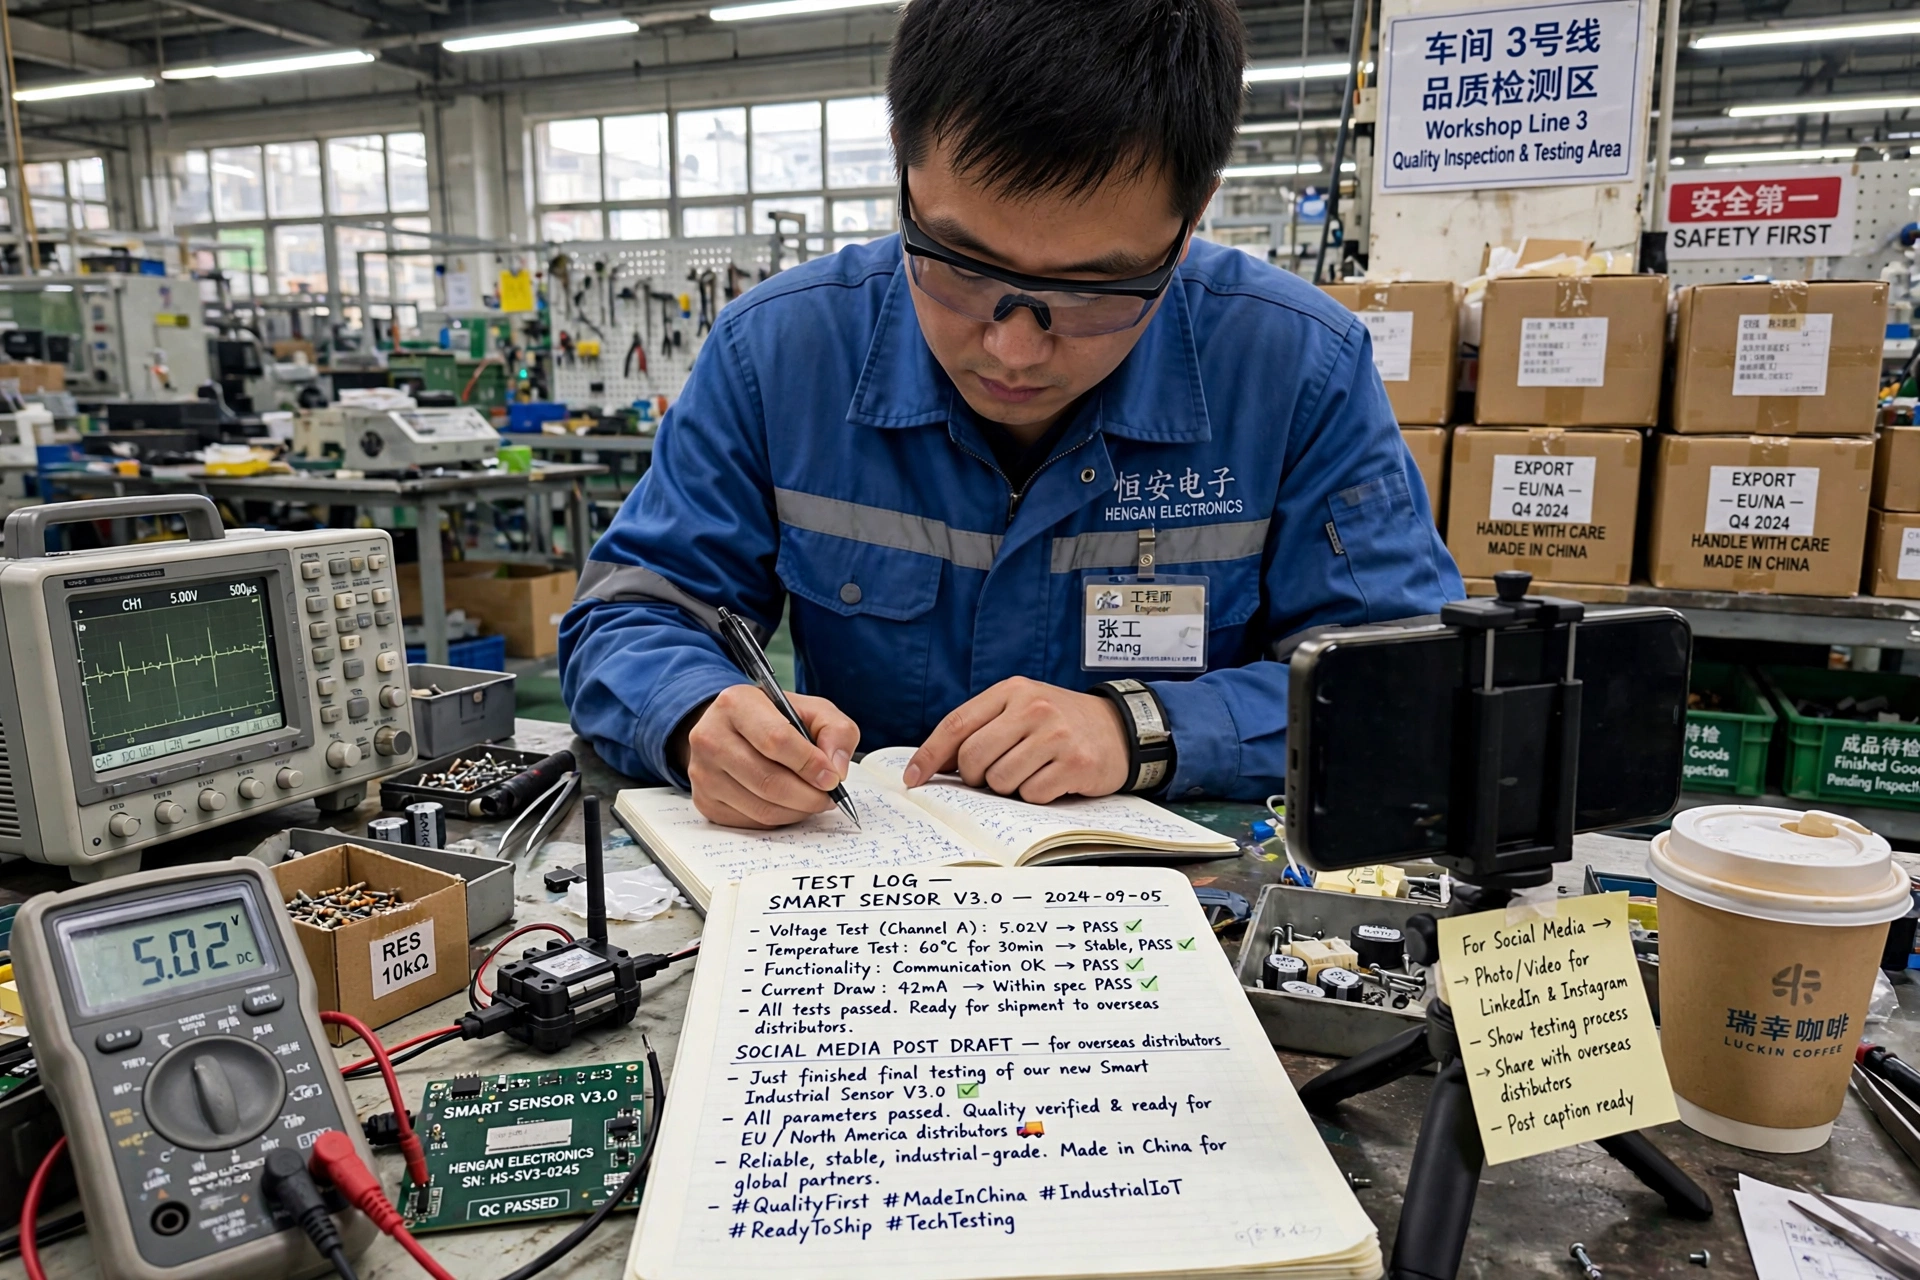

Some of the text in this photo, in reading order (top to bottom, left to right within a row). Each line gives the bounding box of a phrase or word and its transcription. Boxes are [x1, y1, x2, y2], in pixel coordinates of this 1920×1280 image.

[1425, 18, 1601, 65] 车间 3号线
[1423, 65, 1598, 111] 品质检测区
[1426, 111, 1587, 139] Workshop Line 3
[1393, 140, 1621, 172] Quality Inspection & Testing Area
[1691, 185, 1818, 218] 安全第一
[1674, 224, 1831, 248] SAFETY FIRST
[1514, 461, 1574, 476] EXPORT
[1732, 472, 1796, 487] EXPORT
[1113, 467, 1235, 503] 恒安电子
[1519, 482, 1564, 497] EU/NA
[1105, 500, 1243, 521] HENGAN ELECTRONICS
[1512, 502, 1568, 517] Q4 2024
[1737, 494, 1785, 509] EU/NA
[1477, 522, 1606, 540] HANDLE WITH CARE
[1729, 514, 1789, 530] Q4 2024
[1488, 542, 1587, 558] MADE IN CHINA
[1692, 534, 1830, 551] HANDLE WITH CARE
[1704, 555, 1809, 571] MADE IN CHINA
[122, 598, 142, 611] CH1
[170, 590, 198, 604] 5.00V
[1130, 591, 1172, 603] 工程师
[1098, 619, 1141, 638] 张工
[1097, 641, 1141, 656] Zhang
[1688, 745, 1729, 761] Goods
[1834, 755, 1887, 773] Finished
[1827, 773, 1872, 792] Pending
[792, 874, 917, 890] TEST LOG
[769, 890, 1161, 909] SMART SENSOR V3.0 2024-09-05
[231, 914, 240, 927] V
[770, 921, 1118, 941] Voltage Test (Channel A): 5.02V PASS
[383, 932, 420, 961] RES
[1462, 917, 1586, 956] For Social Media
[132, 921, 230, 986] 5.02
[237, 952, 254, 965] DC
[766, 939, 1173, 959] Temperature Test: 60°C for 30min Stable, PASS
[383, 953, 429, 984] 10kΩ
[1474, 949, 1590, 987] Photo/Video for
[1480, 977, 1628, 1017] LinkedIn & Instagram
[758, 998, 1159, 1020] All tests passed. Ready for shipment to overseas
[755, 1020, 852, 1034] distributors.
[1488, 1008, 1628, 1048] Show testing process
[1726, 1008, 1849, 1041] 瑞幸咖啡
[736, 1033, 1221, 1059] SOCIAL MEDIA POST DRAFT for overseas distributors
[1724, 1036, 1843, 1058] LUCKIN COFFEE
[1496, 1037, 1632, 1078] Share with overseas
[750, 1059, 1148, 1088] Just finished final testing of our new Smart
[745, 1085, 945, 1104] Industrial Sensor V3.0
[1500, 1076, 1572, 1102] distibutors
[443, 1089, 618, 1119] SMART SENSOR V3.0
[744, 1094, 1211, 1129] All parameters passed. Quality verified & ready for
[1508, 1088, 1634, 1134] Post caption ready
[449, 1148, 594, 1174] HENGAN ELECTRONICS
[739, 1135, 1226, 1170] Reliable, stable, industrial-grade. Made in China for
[462, 1163, 579, 1188] SN: HS-SV3-0245
[734, 1171, 879, 1198] global partners.
[479, 1197, 558, 1217] QC PASSED
